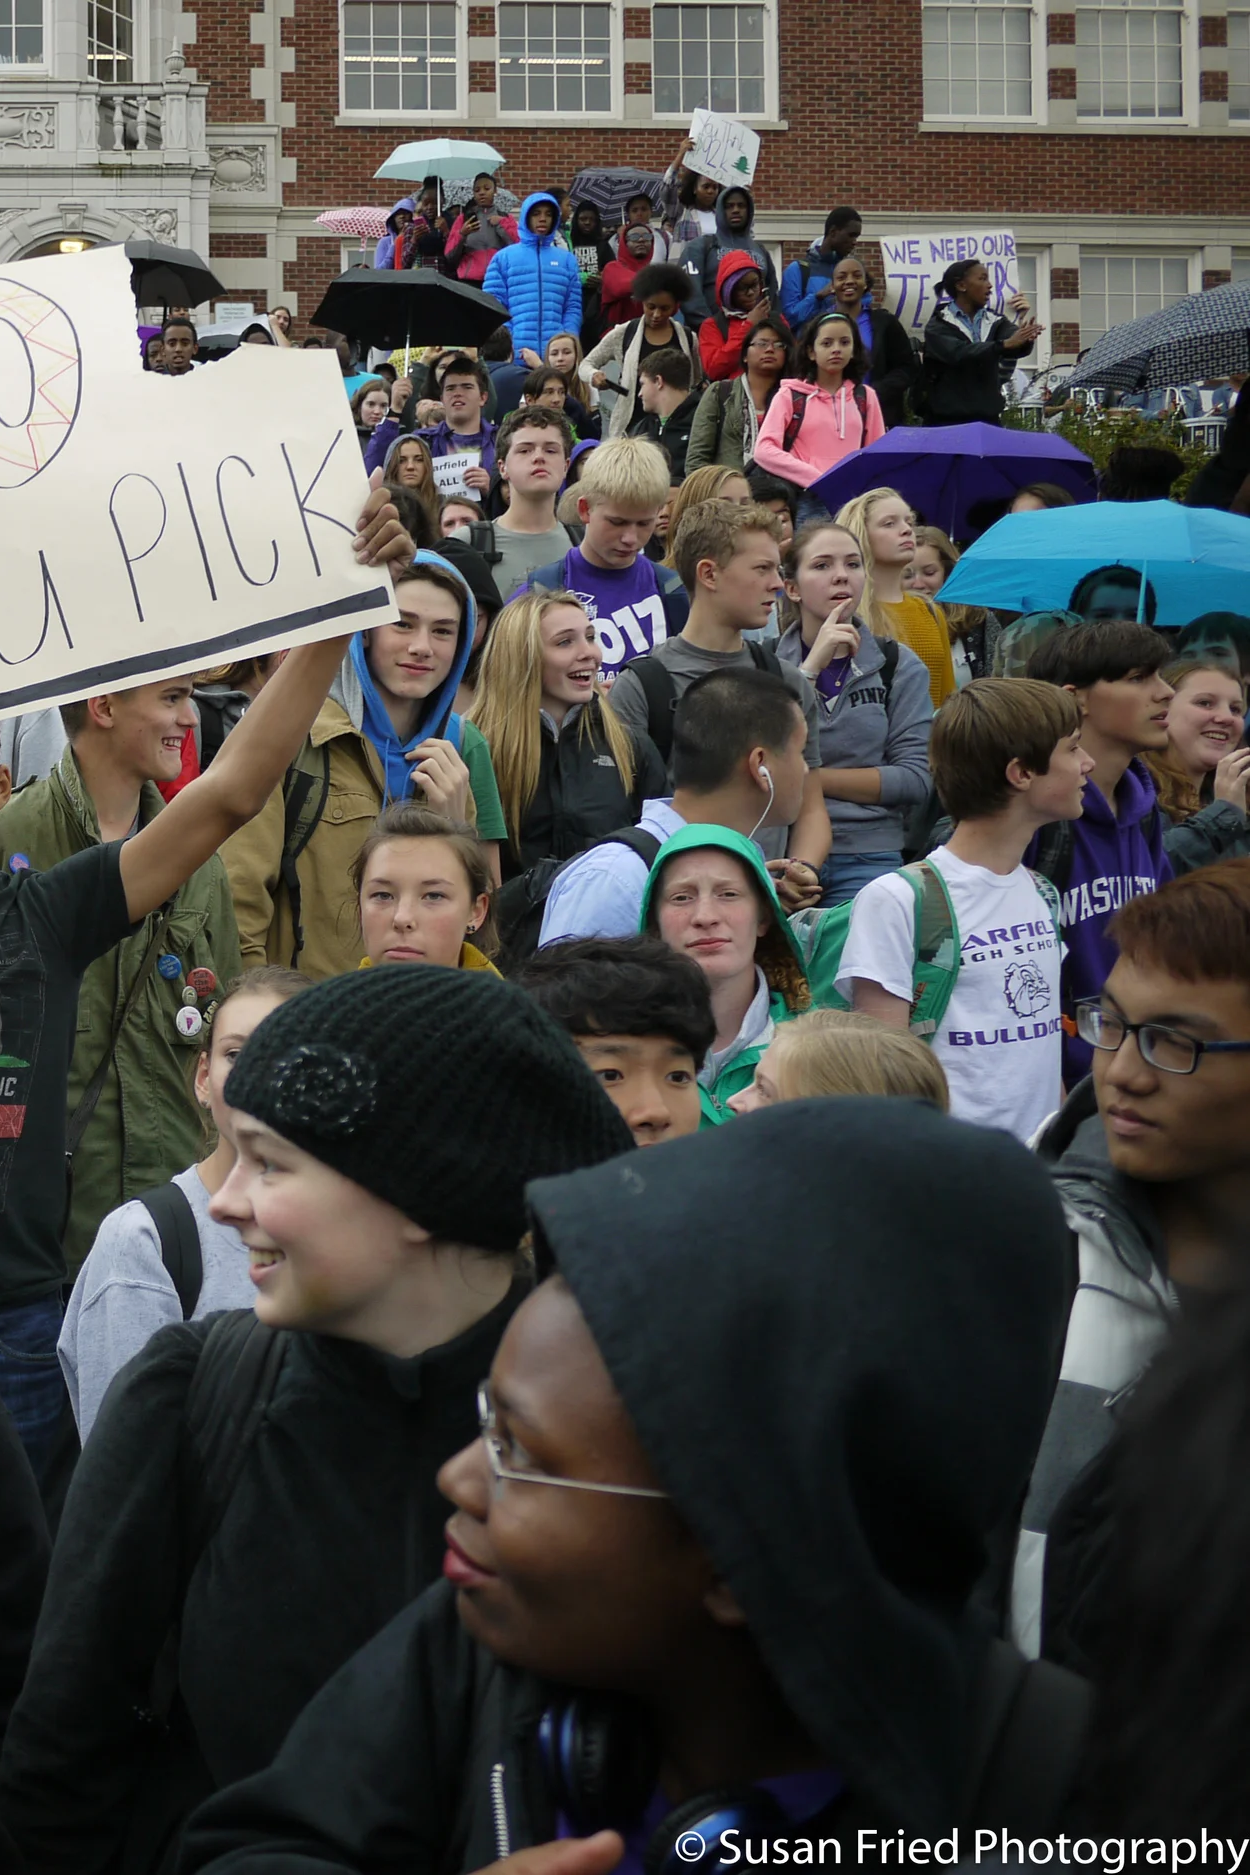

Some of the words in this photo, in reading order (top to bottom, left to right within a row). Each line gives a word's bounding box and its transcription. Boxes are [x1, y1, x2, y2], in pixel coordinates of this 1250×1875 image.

[884, 240, 922, 265] WE
[929, 236, 978, 263] NEED
[982, 234, 1016, 257] OUR
[888, 257, 1018, 328] TEERS
[432, 459, 468, 472] arfield
[439, 476, 460, 488] ALL
[109, 429, 357, 623] PICK
[590, 593, 668, 665] 017
[959, 918, 1058, 951] ARFIEL
[959, 949, 1004, 967] IGH
[947, 1016, 1062, 1047] BULLDO
